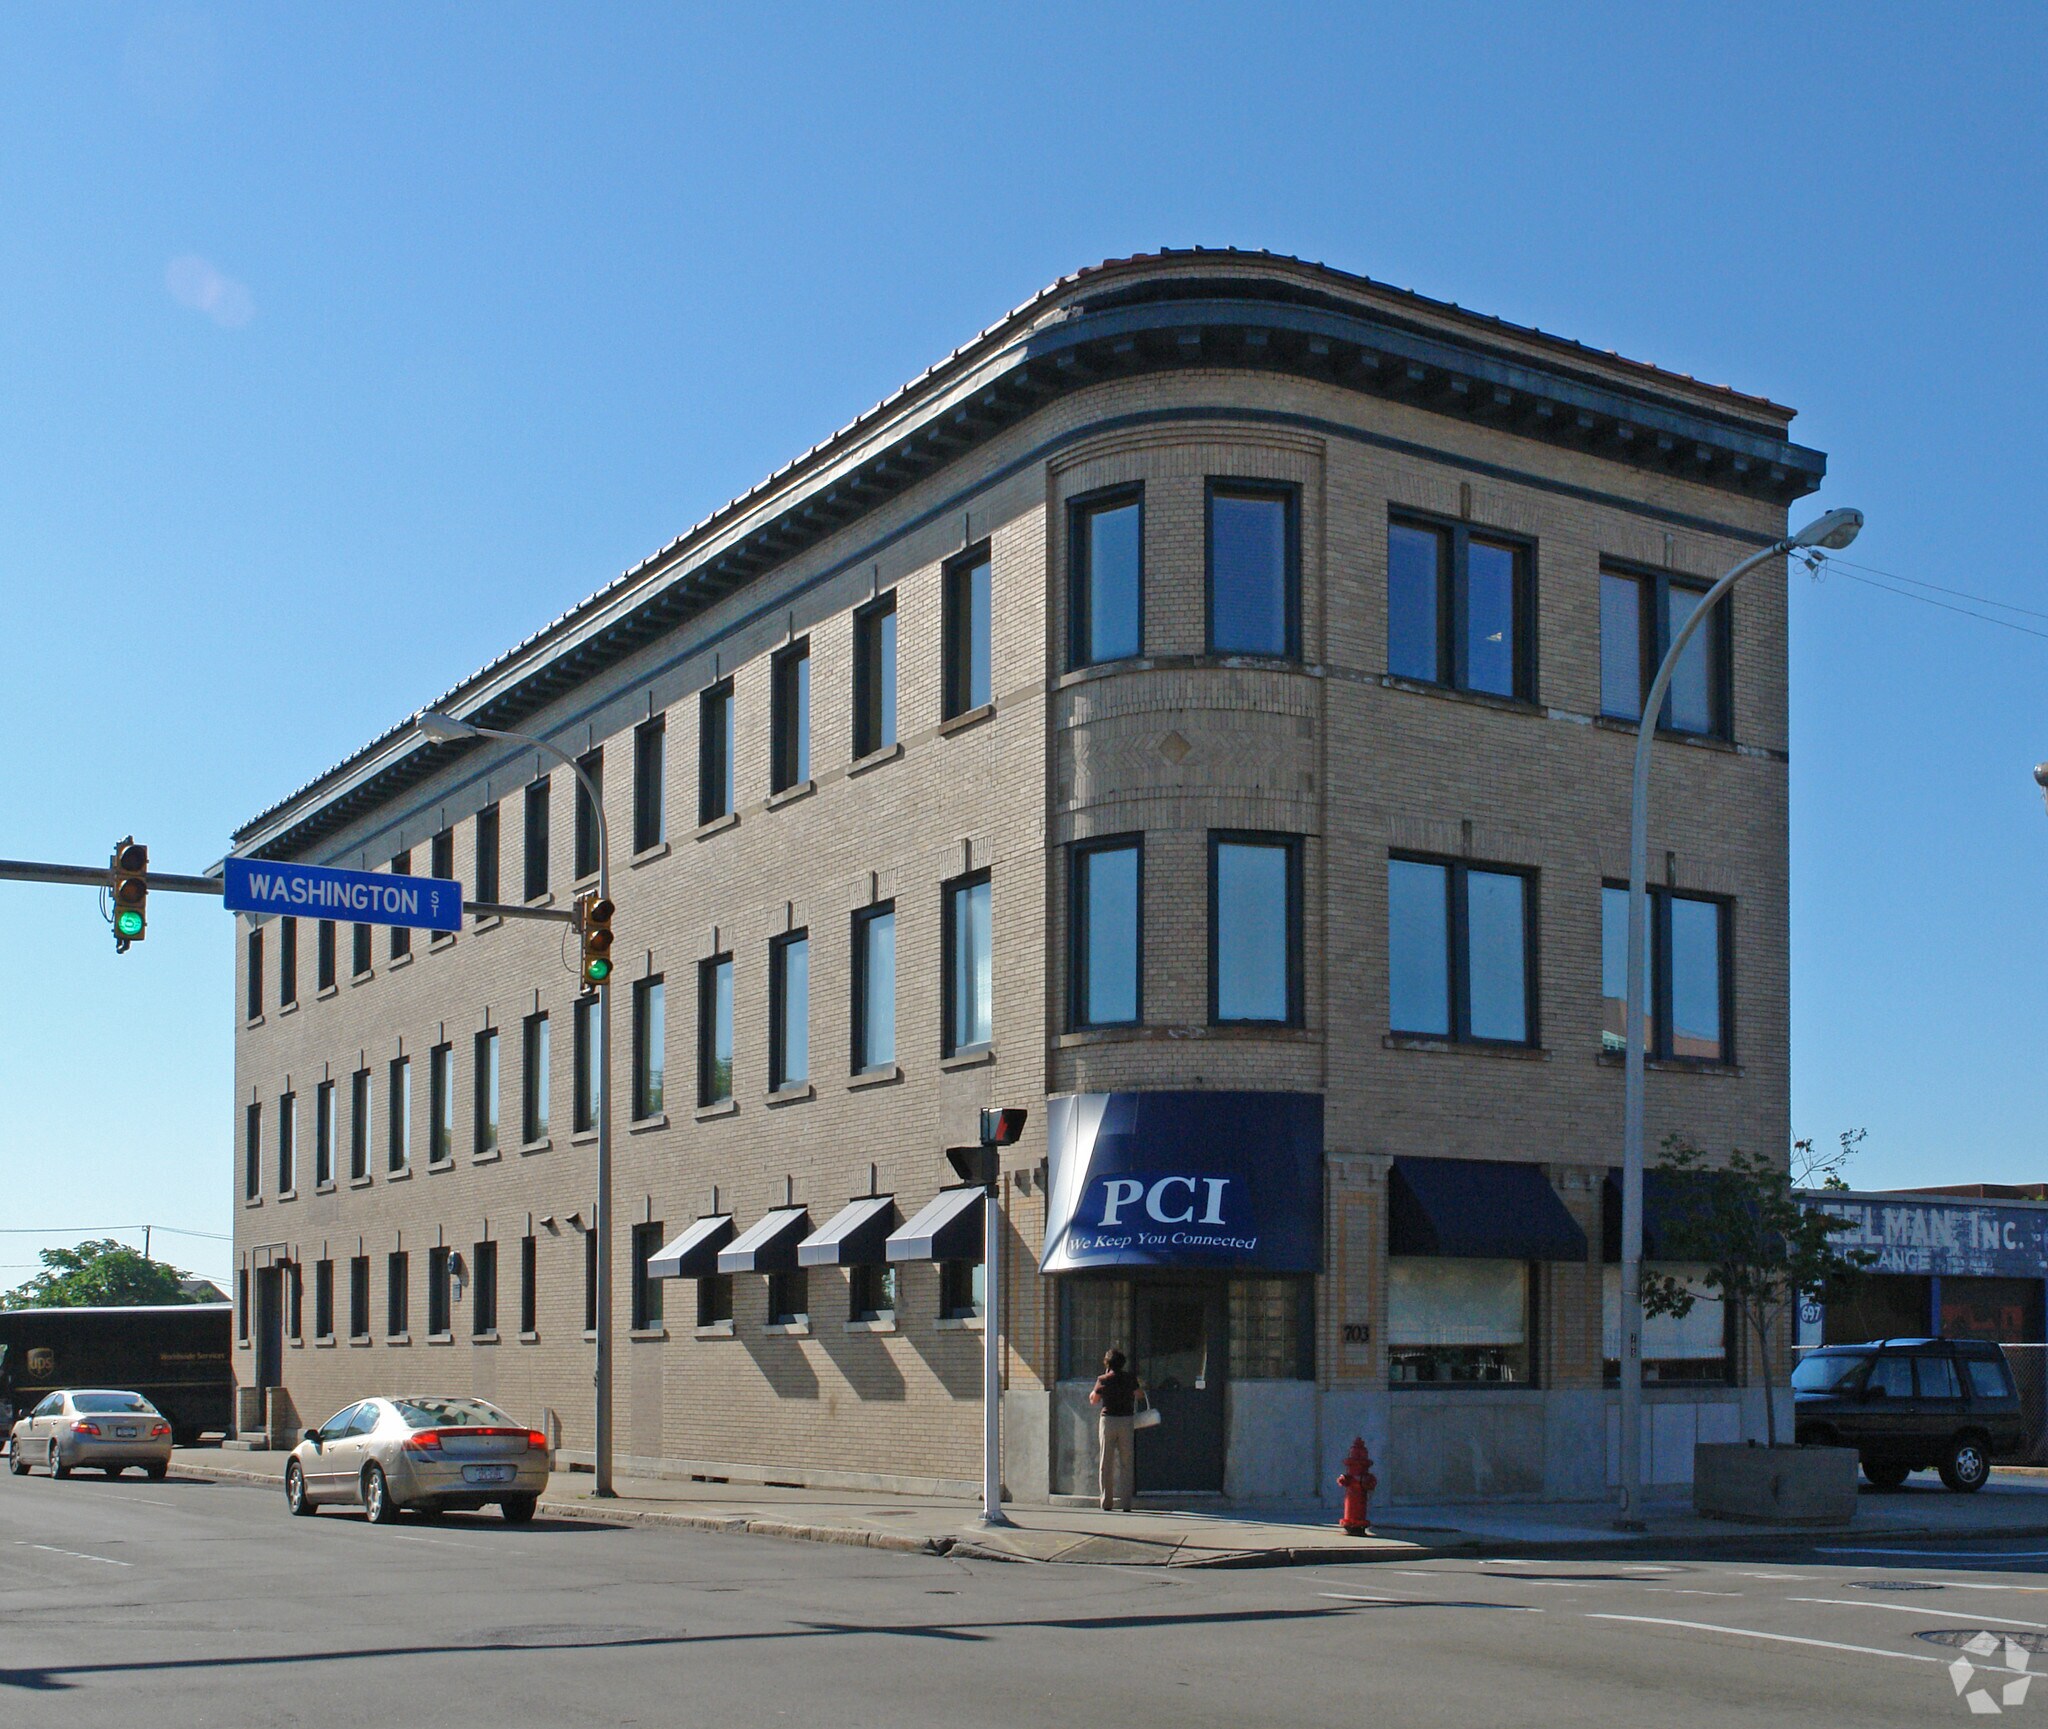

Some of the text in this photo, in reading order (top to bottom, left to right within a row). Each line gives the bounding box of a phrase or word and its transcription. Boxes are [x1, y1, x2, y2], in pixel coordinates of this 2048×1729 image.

[249, 873, 439, 918] WASHINGTON ST
[1097, 1176, 1231, 1227] PCI
[1070, 1231, 1257, 1251] We Keep You Connected
[1969, 1209, 2024, 1251] INC.
[1801, 1306, 1820, 1321] 697
[1343, 1324, 1369, 1342] 703
